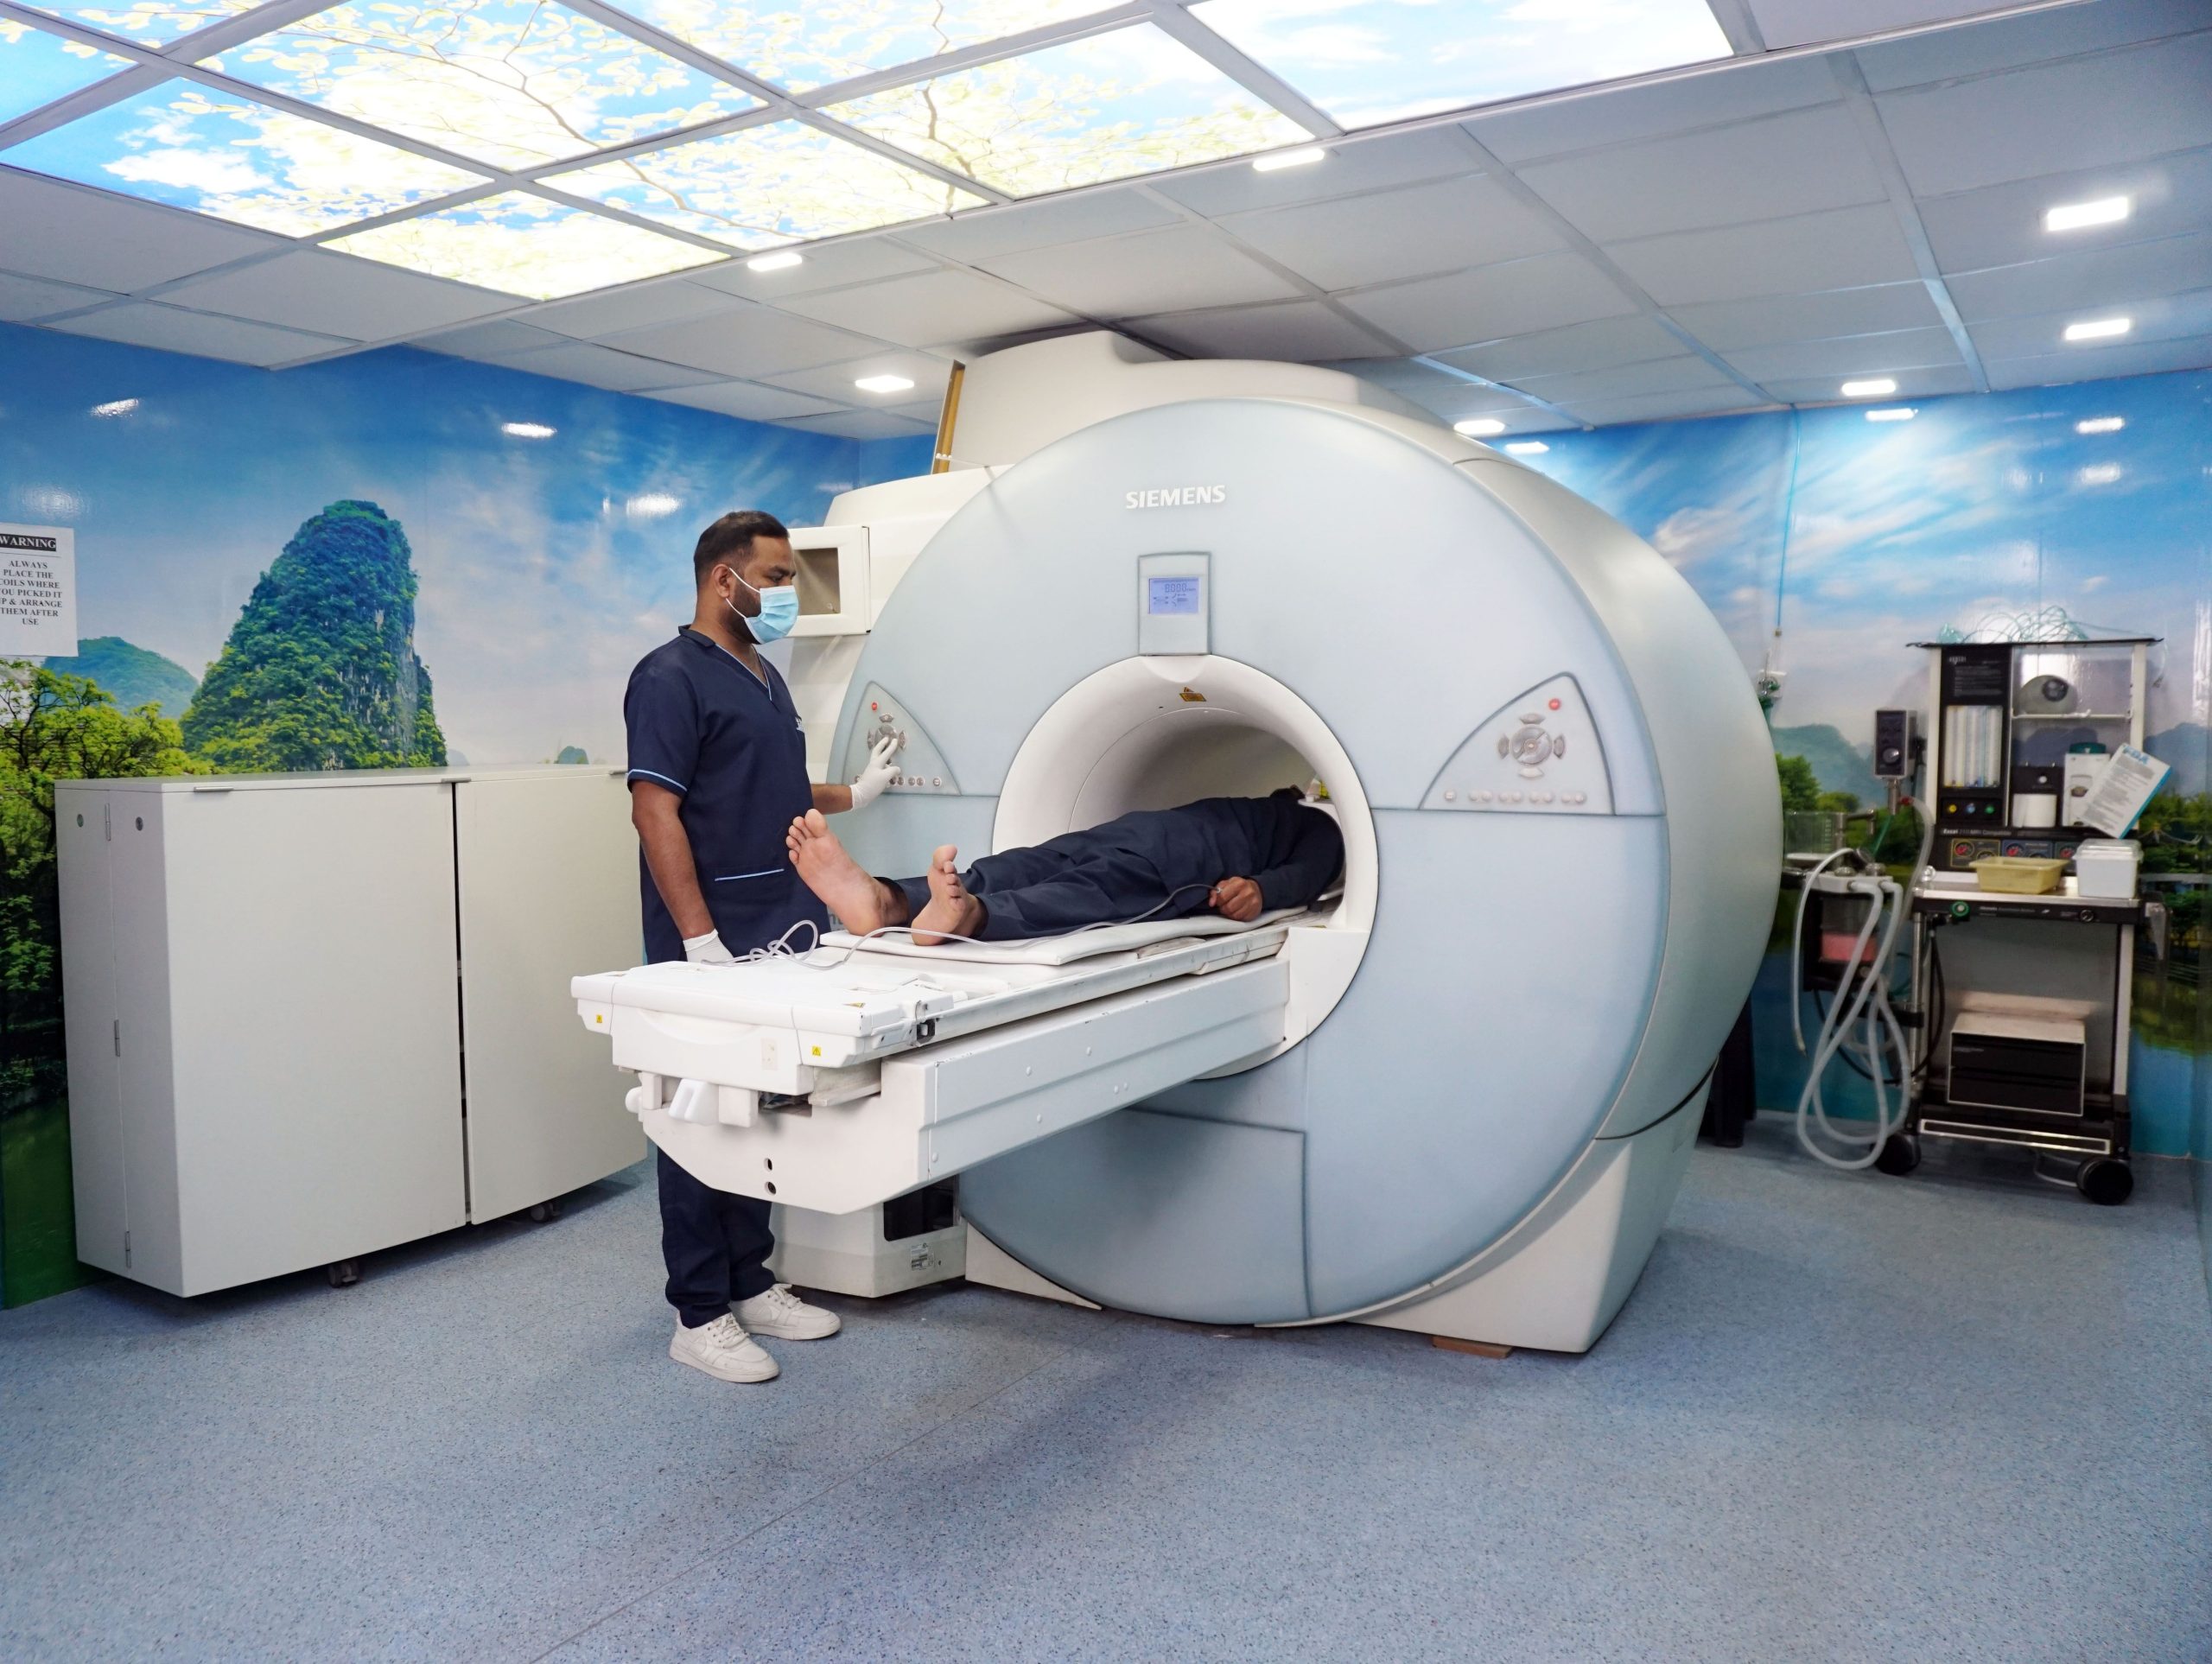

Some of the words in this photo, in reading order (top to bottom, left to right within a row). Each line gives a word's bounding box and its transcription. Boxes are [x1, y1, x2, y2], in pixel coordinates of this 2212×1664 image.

[1126, 485, 1226, 509] SIEMENS
[0, 536, 56, 549] WARNING
[3, 568, 34, 577] PLACE
[27, 580, 60, 588] WHERE
[19, 599, 62, 607] ARRANGE
